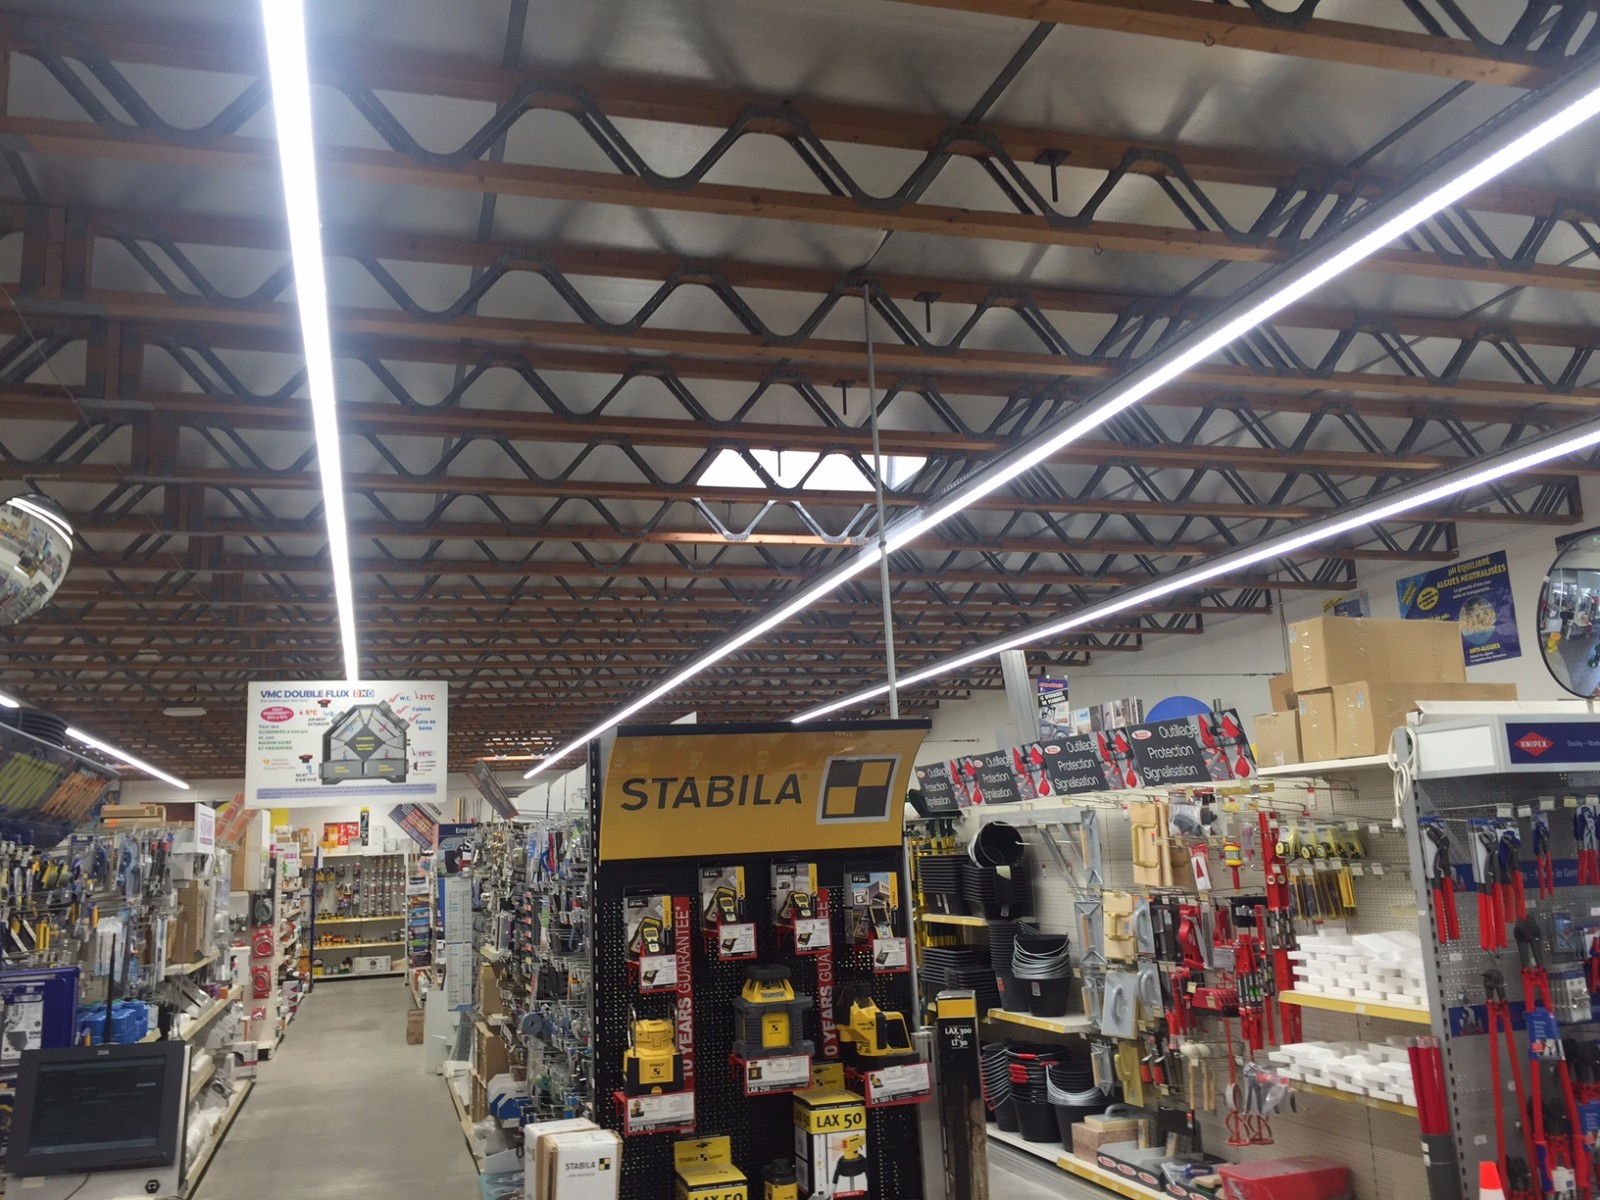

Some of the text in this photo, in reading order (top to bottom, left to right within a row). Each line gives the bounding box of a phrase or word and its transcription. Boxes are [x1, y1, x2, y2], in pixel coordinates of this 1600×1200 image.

[1436, 563, 1507, 589] ALGUES NEUTRALISÉES
[260, 689, 349, 698] VMC DOUBLE FLUX
[1158, 723, 1199, 739] Outillage
[1065, 740, 1098, 753] Outillage
[1520, 740, 1548, 748] KNIPEX
[1147, 744, 1195, 760] Protection
[985, 755, 1013, 768] Outillage
[1057, 758, 1096, 772] Protection
[927, 767, 950, 778] Outillage
[982, 772, 1010, 783] Protection
[1143, 764, 1199, 782] Signalisation
[1054, 774, 1100, 792] Signalisation
[620, 773, 802, 811] STABILA
[982, 787, 1013, 801] Signalisation
[820, 985, 838, 1043] YEARS
[677, 997, 694, 1055] YEARS
[945, 1027, 959, 1035] LAX
[816, 1112, 862, 1129] LAX 50
[628, 1124, 644, 1133] LAPR
[565, 1161, 596, 1170] STABILA
